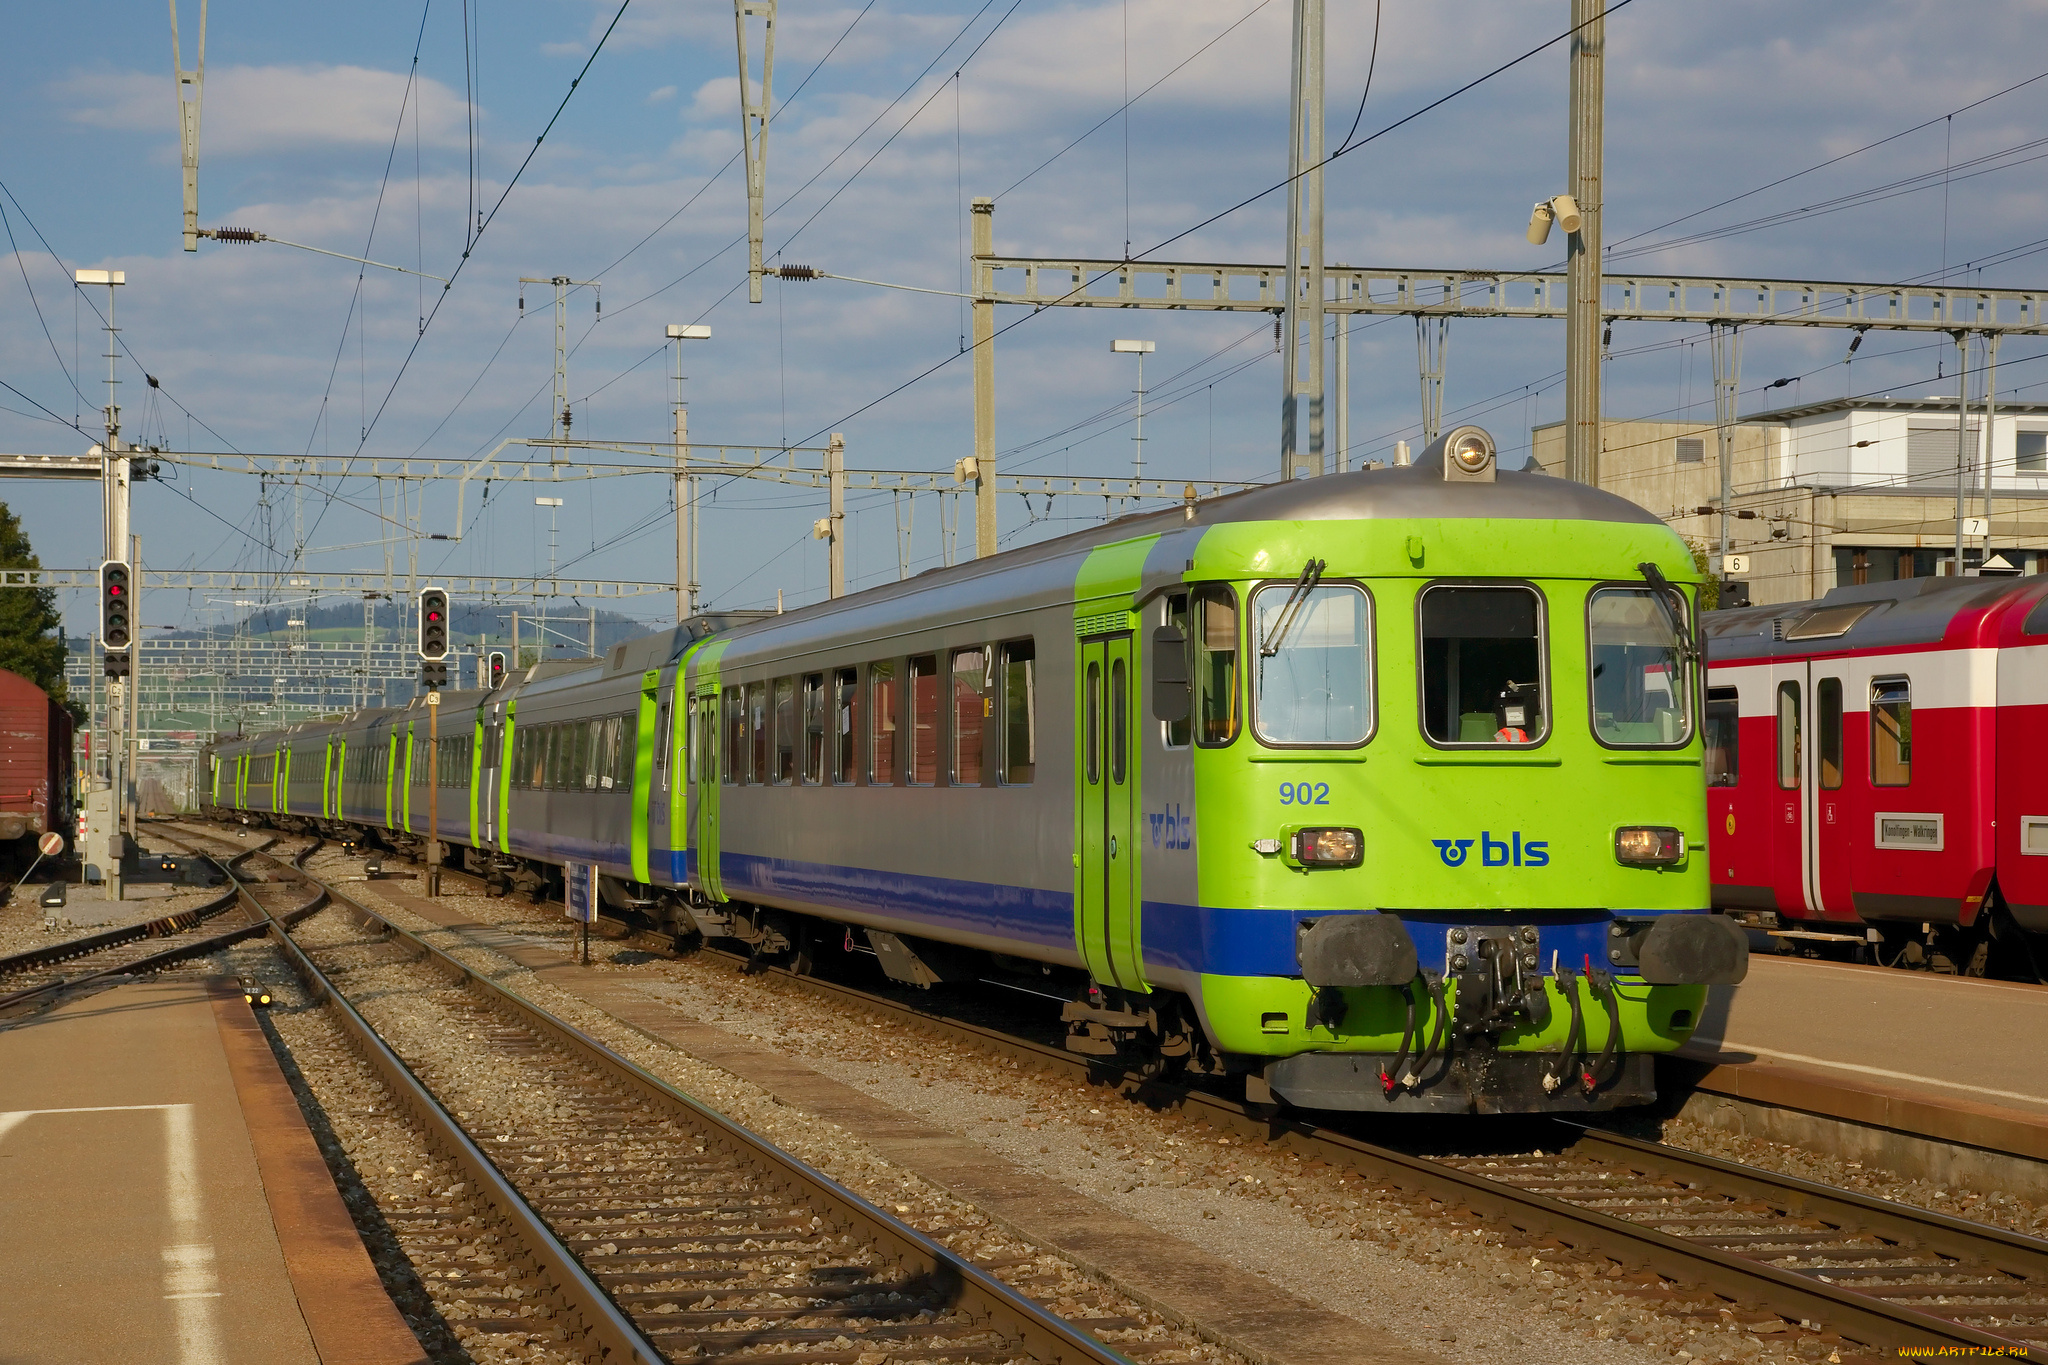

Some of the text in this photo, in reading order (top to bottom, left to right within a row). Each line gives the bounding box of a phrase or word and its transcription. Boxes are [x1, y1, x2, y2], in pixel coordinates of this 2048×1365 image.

[1973, 520, 1979, 533] 7
[1733, 557, 1741, 571] 6
[985, 644, 993, 688] 2
[740, 686, 745, 717] 2
[1279, 782, 1330, 806] 902
[1166, 802, 1191, 850] bls
[1481, 831, 1550, 867] bls
